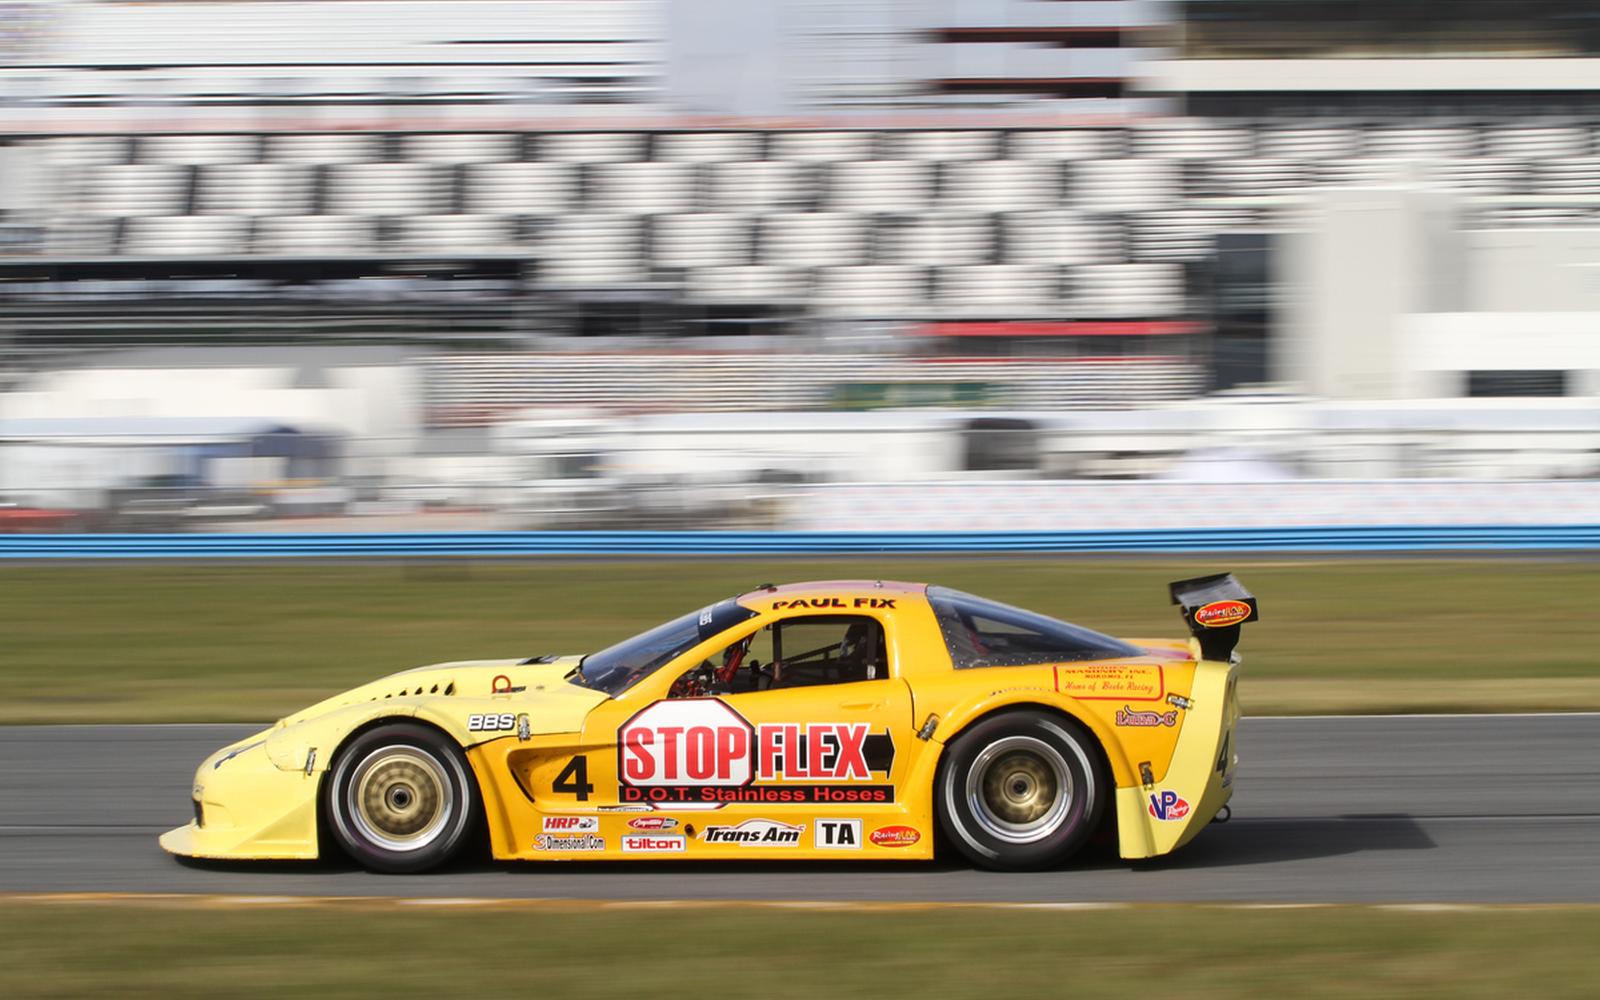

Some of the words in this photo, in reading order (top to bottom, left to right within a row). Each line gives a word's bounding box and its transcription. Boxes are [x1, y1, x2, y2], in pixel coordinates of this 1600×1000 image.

[772, 598, 847, 610] PAUL
[853, 598, 897, 609] FIX
[468, 714, 516, 731] BBS
[626, 726, 746, 779] STOP
[757, 723, 871, 780] FLEX
[552, 755, 594, 801] 4
[625, 787, 693, 800] D.O.T.
[701, 787, 805, 801] Stainless
[814, 787, 886, 800] Hoses
[1150, 791, 1177, 820] VP
[544, 817, 580, 829] HRP
[705, 826, 761, 841] Trans
[762, 826, 800, 841] Am
[821, 823, 855, 844] TA
[626, 838, 681, 849] tilton
